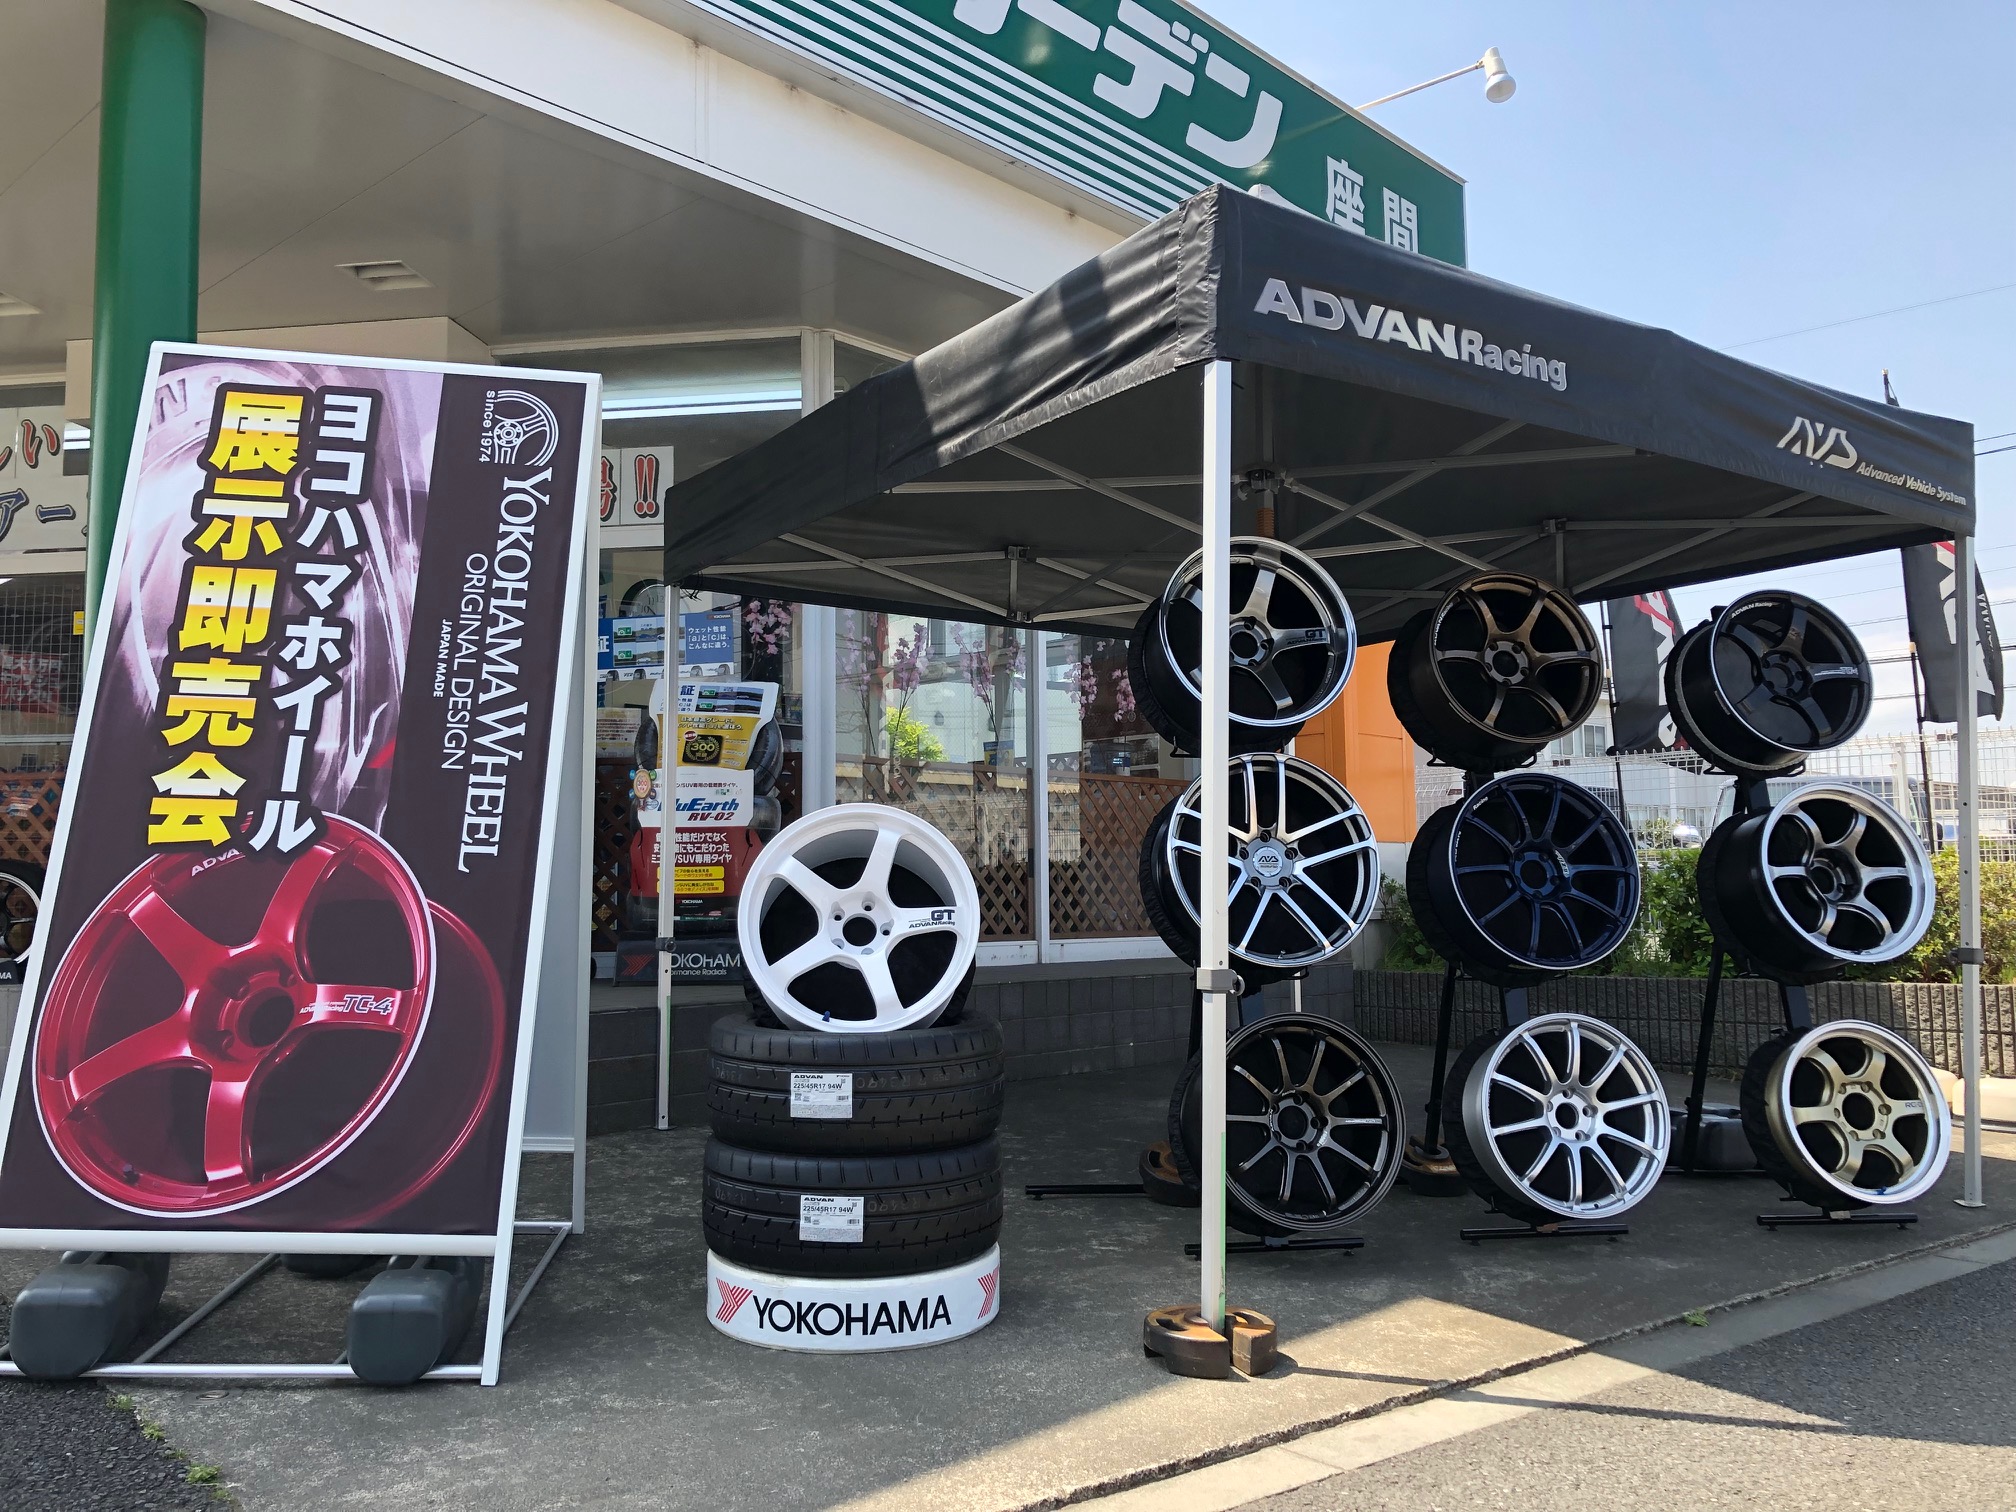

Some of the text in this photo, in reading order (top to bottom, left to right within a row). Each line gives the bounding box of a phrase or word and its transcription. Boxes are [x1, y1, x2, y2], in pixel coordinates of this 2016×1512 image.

[953, 0, 1283, 168] ーデン
[1253, 277, 1567, 392] ADVAN Racing
[478, 431, 493, 463] 1974
[1856, 461, 1906, 486] Advanced
[1905, 474, 1936, 496] Vehicle
[1936, 485, 1967, 506] System
[147, 390, 304, 848] 展示即売会
[249, 393, 374, 853] ヨコハマホイール
[433, 618, 453, 698] JAPAN MADE
[441, 553, 489, 770] ORIGINAL DESIGN
[457, 467, 553, 874] YOKOHAMA WHEEL
[691, 743, 715, 751] 300
[657, 798, 739, 812] luEarth
[688, 812, 735, 821] RV-02
[191, 848, 243, 877] ADVA
[908, 920, 938, 929] ADVAN
[931, 909, 956, 921] GT
[670, 953, 741, 968] OKOHAM
[702, 968, 727, 976] Radials
[343, 994, 395, 1015] TC-4
[793, 1082, 826, 1090] 225/45R17
[802, 1205, 837, 1213] 225/45R17
[752, 1294, 952, 1336] YOKOHAMA
